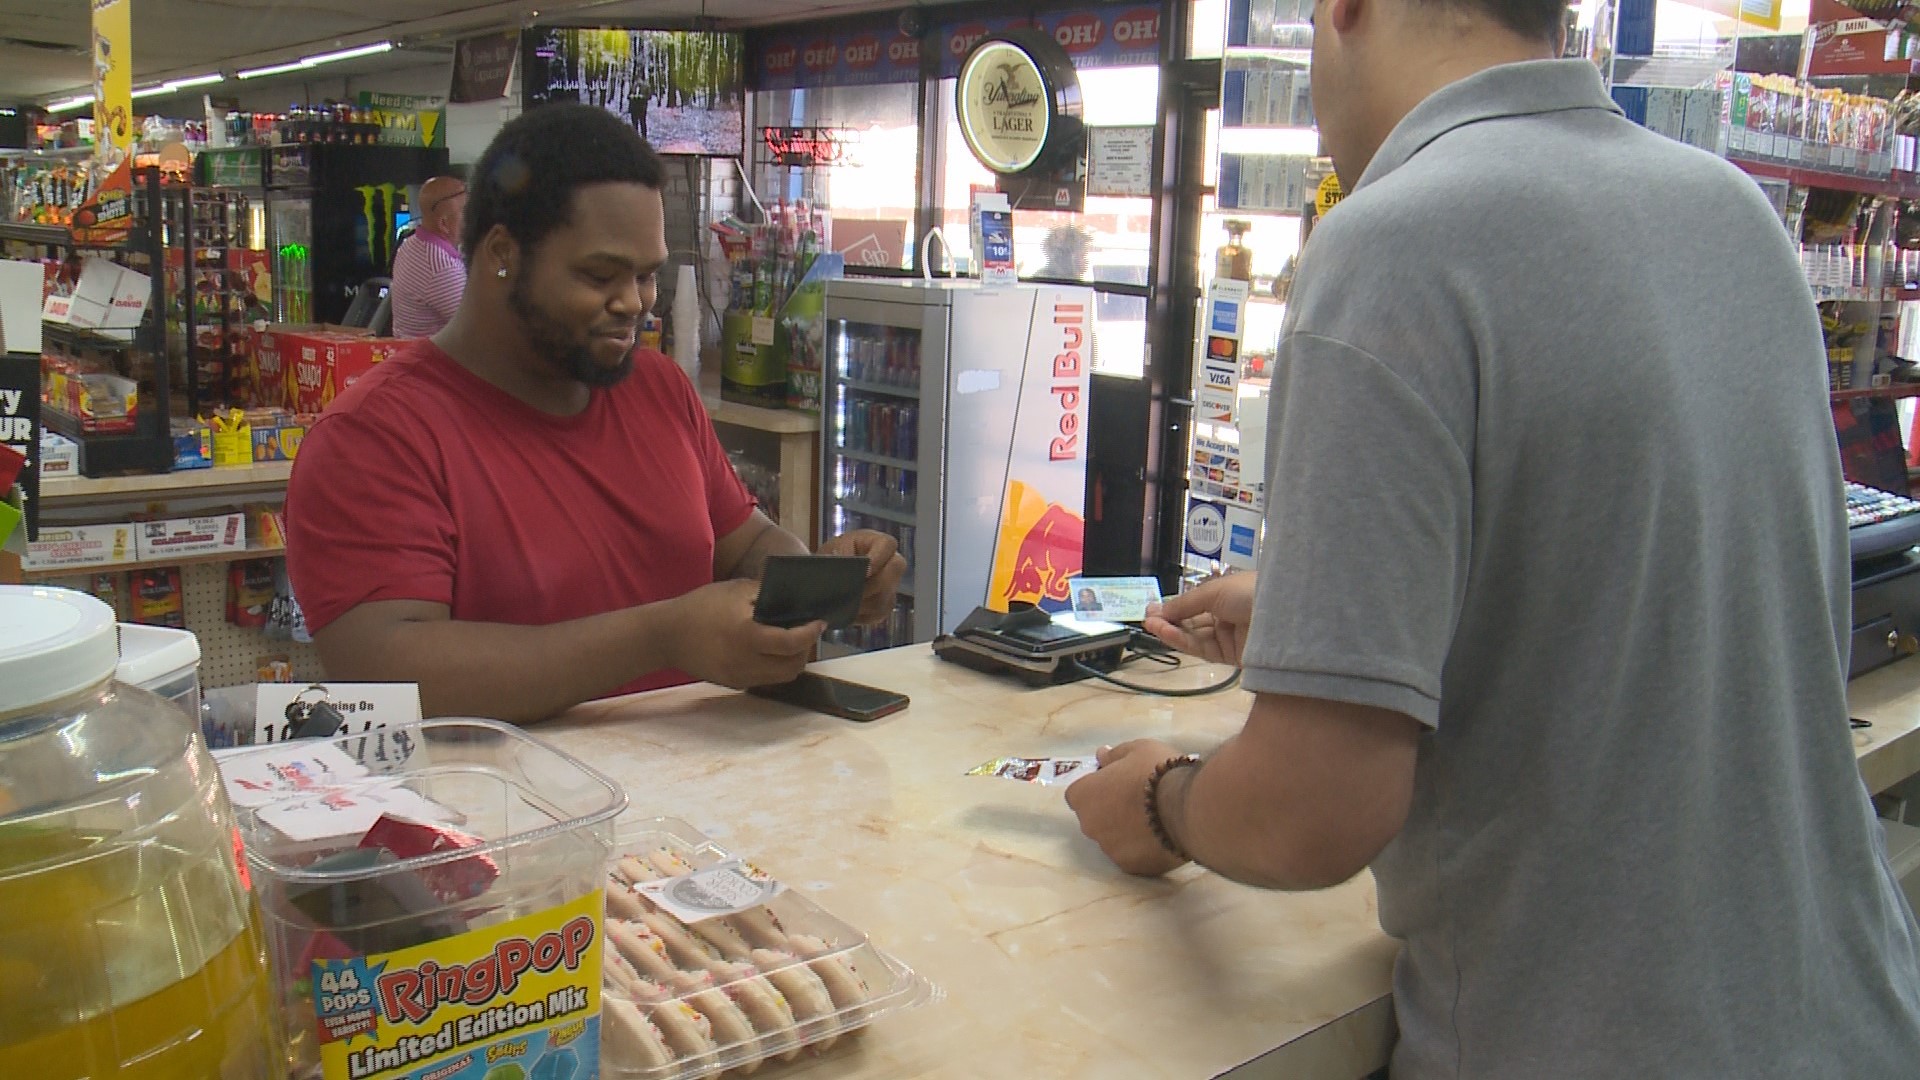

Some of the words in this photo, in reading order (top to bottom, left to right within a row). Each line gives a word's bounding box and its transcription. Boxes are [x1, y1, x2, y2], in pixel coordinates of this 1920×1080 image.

[1055, 20, 1100, 45] OH!
[1113, 13, 1160, 41] OH!
[1845, 21, 1868, 31] MINI
[844, 41, 880, 63] OH!
[888, 42, 919, 60] OH
[950, 30, 990, 54] OH
[803, 45, 836, 67] OH!
[373, 110, 417, 131] ATM
[993, 117, 1033, 132] LAGER
[1053, 304, 1084, 379] Bull
[1209, 372, 1232, 386] VISA
[1202, 400, 1231, 411] DISCOVER
[1049, 386, 1080, 462] Red
[1206, 440, 1226, 452] Accept
[298, 700, 356, 713] Bening
[359, 701, 374, 711] On
[320, 968, 360, 994] 44
[321, 988, 372, 1013] POPS
[547, 985, 589, 1019] Mix
[455, 1000, 546, 1045] Edition
[348, 1021, 454, 1079] Limited
[421, 1054, 474, 1080] ORIGINAL
